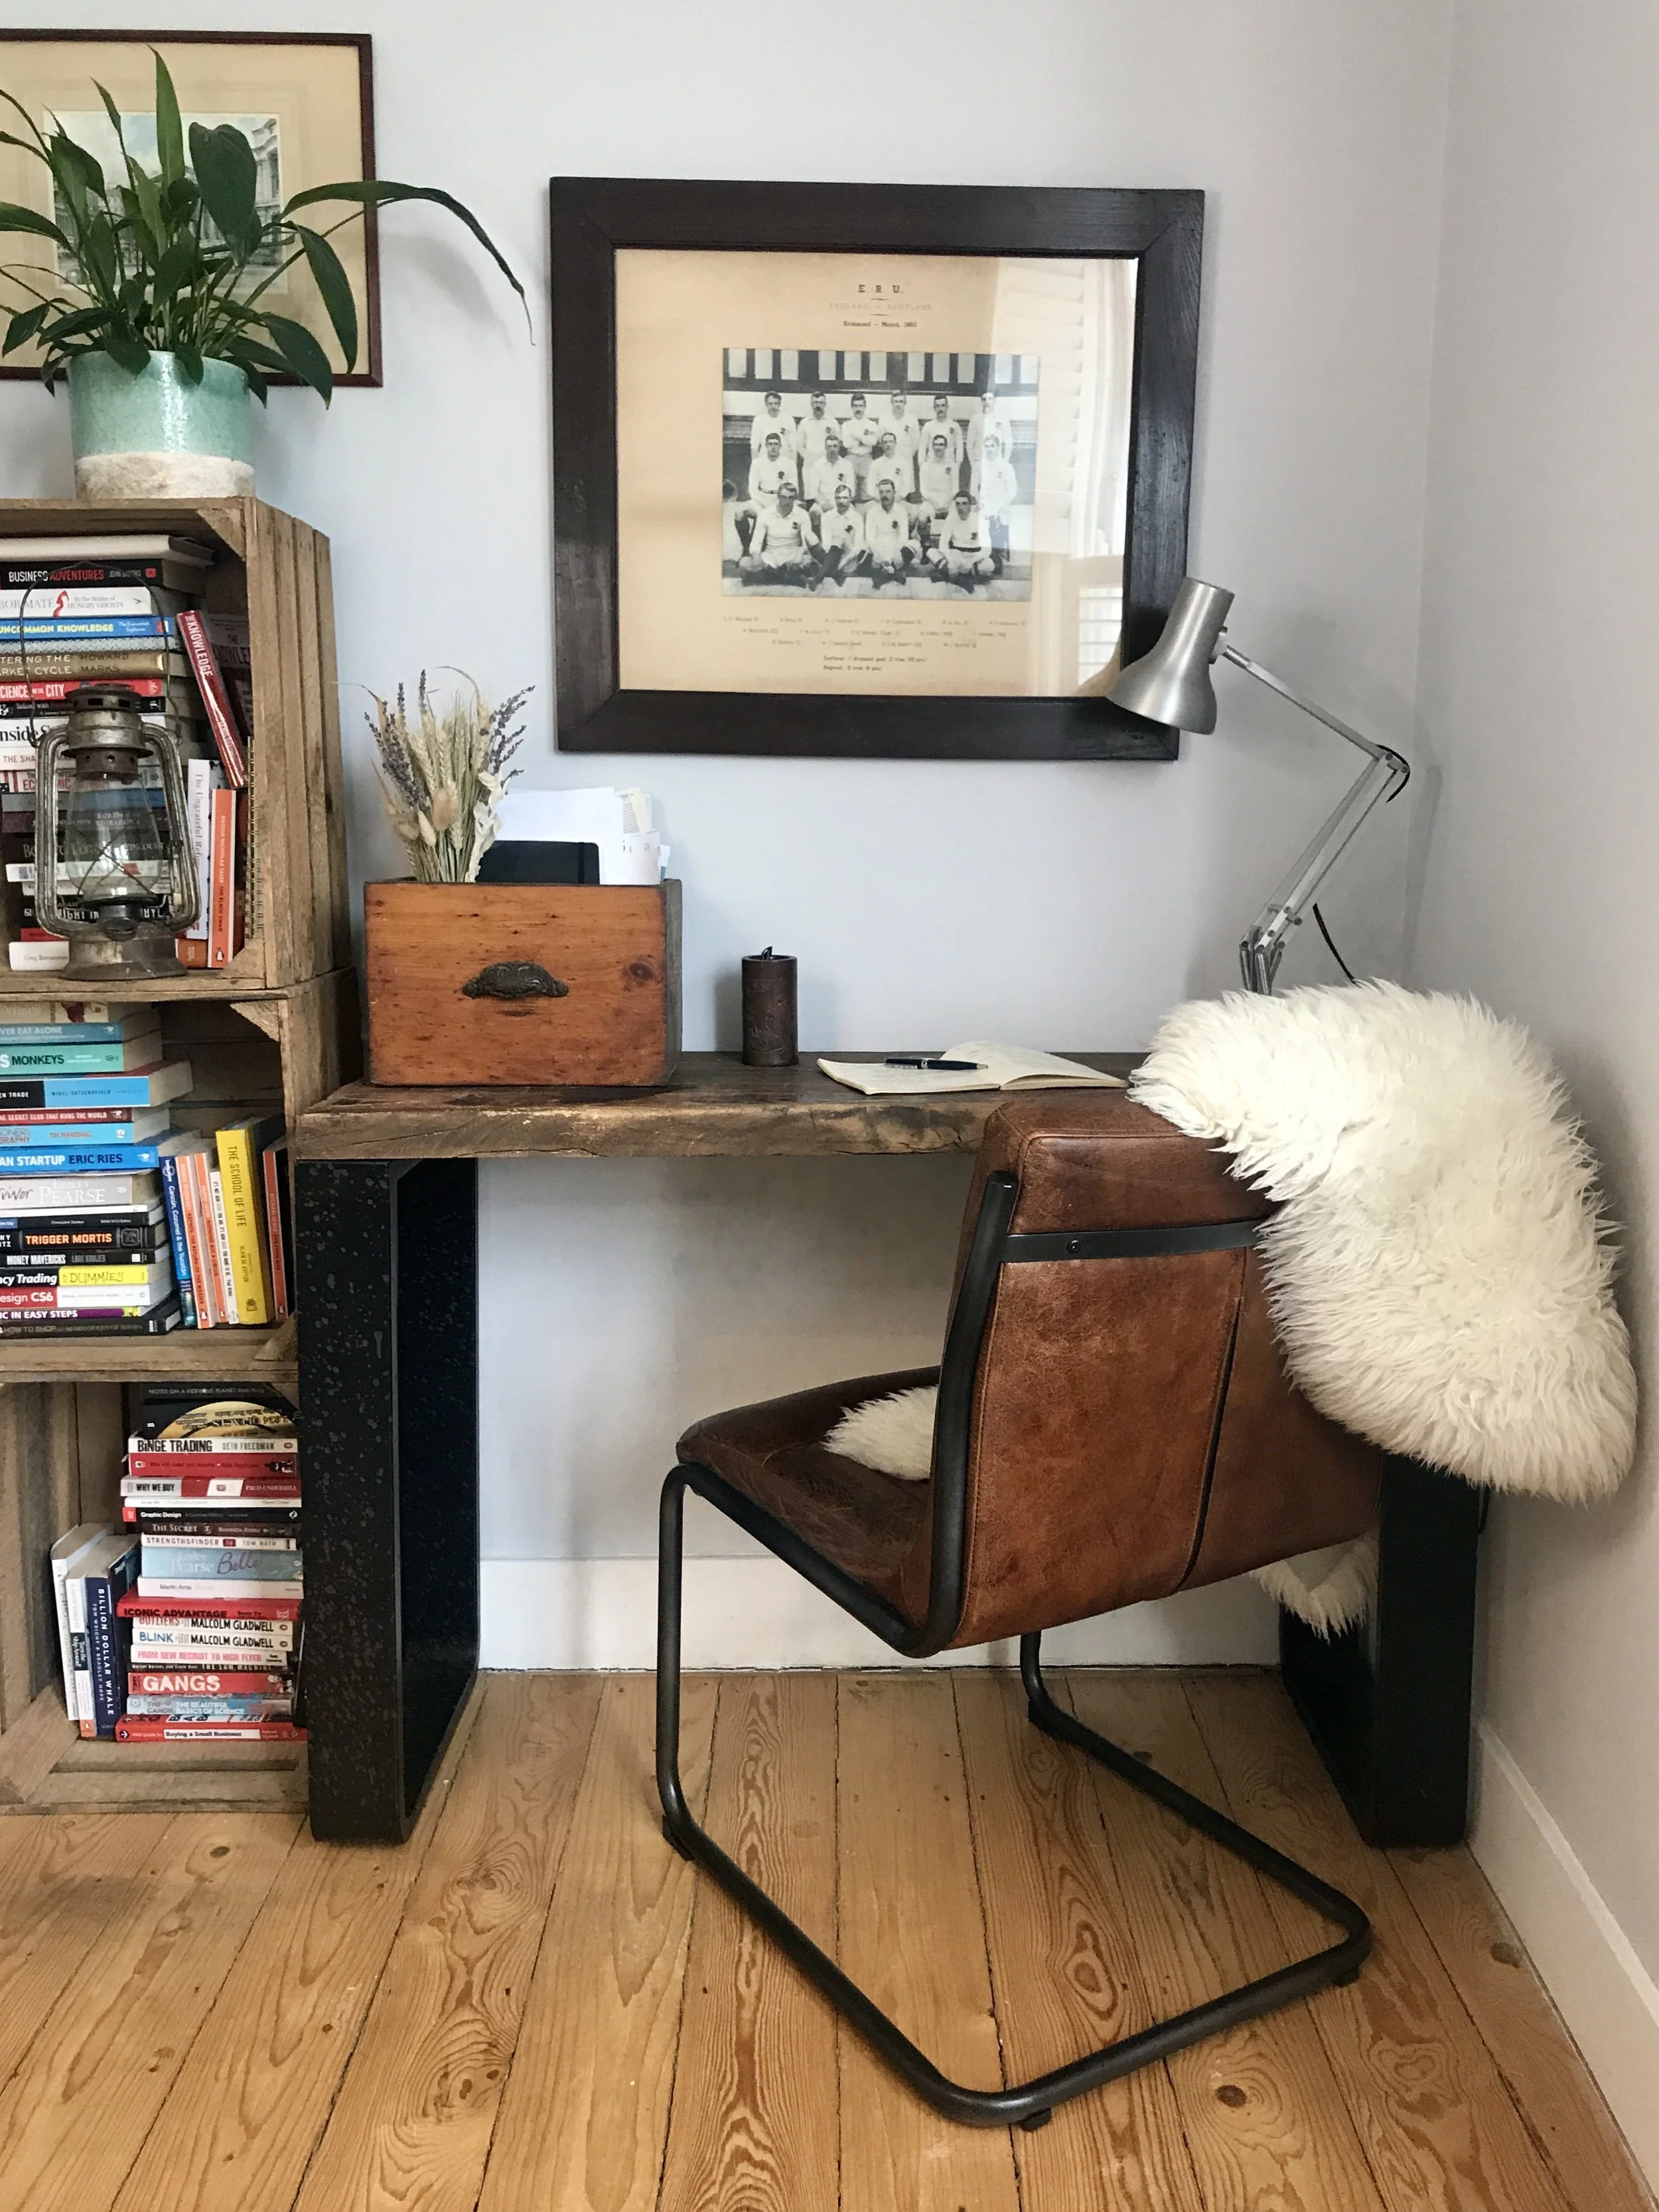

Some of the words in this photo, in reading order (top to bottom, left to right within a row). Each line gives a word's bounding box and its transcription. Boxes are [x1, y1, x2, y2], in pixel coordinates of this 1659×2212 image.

[9, 571, 48, 582] BUSINESS
[50, 569, 104, 581] ADVENTURES
[57, 623, 113, 633] KNOWLEDGE
[186, 622, 213, 677] KNOWLEDGE
[1, 655, 42, 664] TERNG
[35, 666, 72, 675] CYCLE
[46, 684, 64, 698] CITY
[193, 792, 204, 839] Ungrateful
[11, 1054, 65, 1066] MONKEYS
[68, 1154, 95, 1165] ERIC
[97, 1153, 123, 1163] RIES
[228, 1145, 240, 1160] THE
[17, 1155, 66, 1166] STARTUP
[230, 1163, 244, 1195] SCHOOL
[38, 1185, 106, 1205] PEARSE
[234, 1197, 244, 1209] OF
[235, 1210, 247, 1227] LIFE
[25, 1234, 70, 1246] TRIGGER
[72, 1233, 113, 1244] MORTIS
[7, 1254, 29, 1266] MONEY
[31, 1254, 66, 1265] MAVERICKS
[16, 1273, 58, 1286] Trading
[69, 1272, 124, 1283] DUMMIES
[31, 1291, 54, 1302] CS6
[50, 1309, 78, 1318] STEPS
[169, 1439, 212, 1452] TRADING
[163, 1483, 175, 1492] BUY
[152, 1523, 168, 1532] THE
[169, 1523, 198, 1532] SECRET
[217, 1550, 260, 1575] Belle
[98, 1588, 108, 1630] BILLION
[124, 1608, 161, 1617] ICONIC
[163, 1609, 228, 1619] ADVANTAGE
[139, 1616, 180, 1627] OUTLIERS
[191, 1618, 231, 1629] MALCOLM
[233, 1619, 274, 1632] GLADWELL
[139, 1631, 174, 1643] BLINK
[190, 1634, 230, 1646] MALCOLM
[233, 1636, 274, 1649] GLADWELL
[102, 1635, 111, 1675] DOLLAR
[137, 1651, 158, 1659] FROM
[161, 1651, 177, 1659] NEW
[179, 1651, 208, 1660] RECRUIT
[143, 1675, 221, 1692] GANGS
[106, 1680, 114, 1716] WHALE
